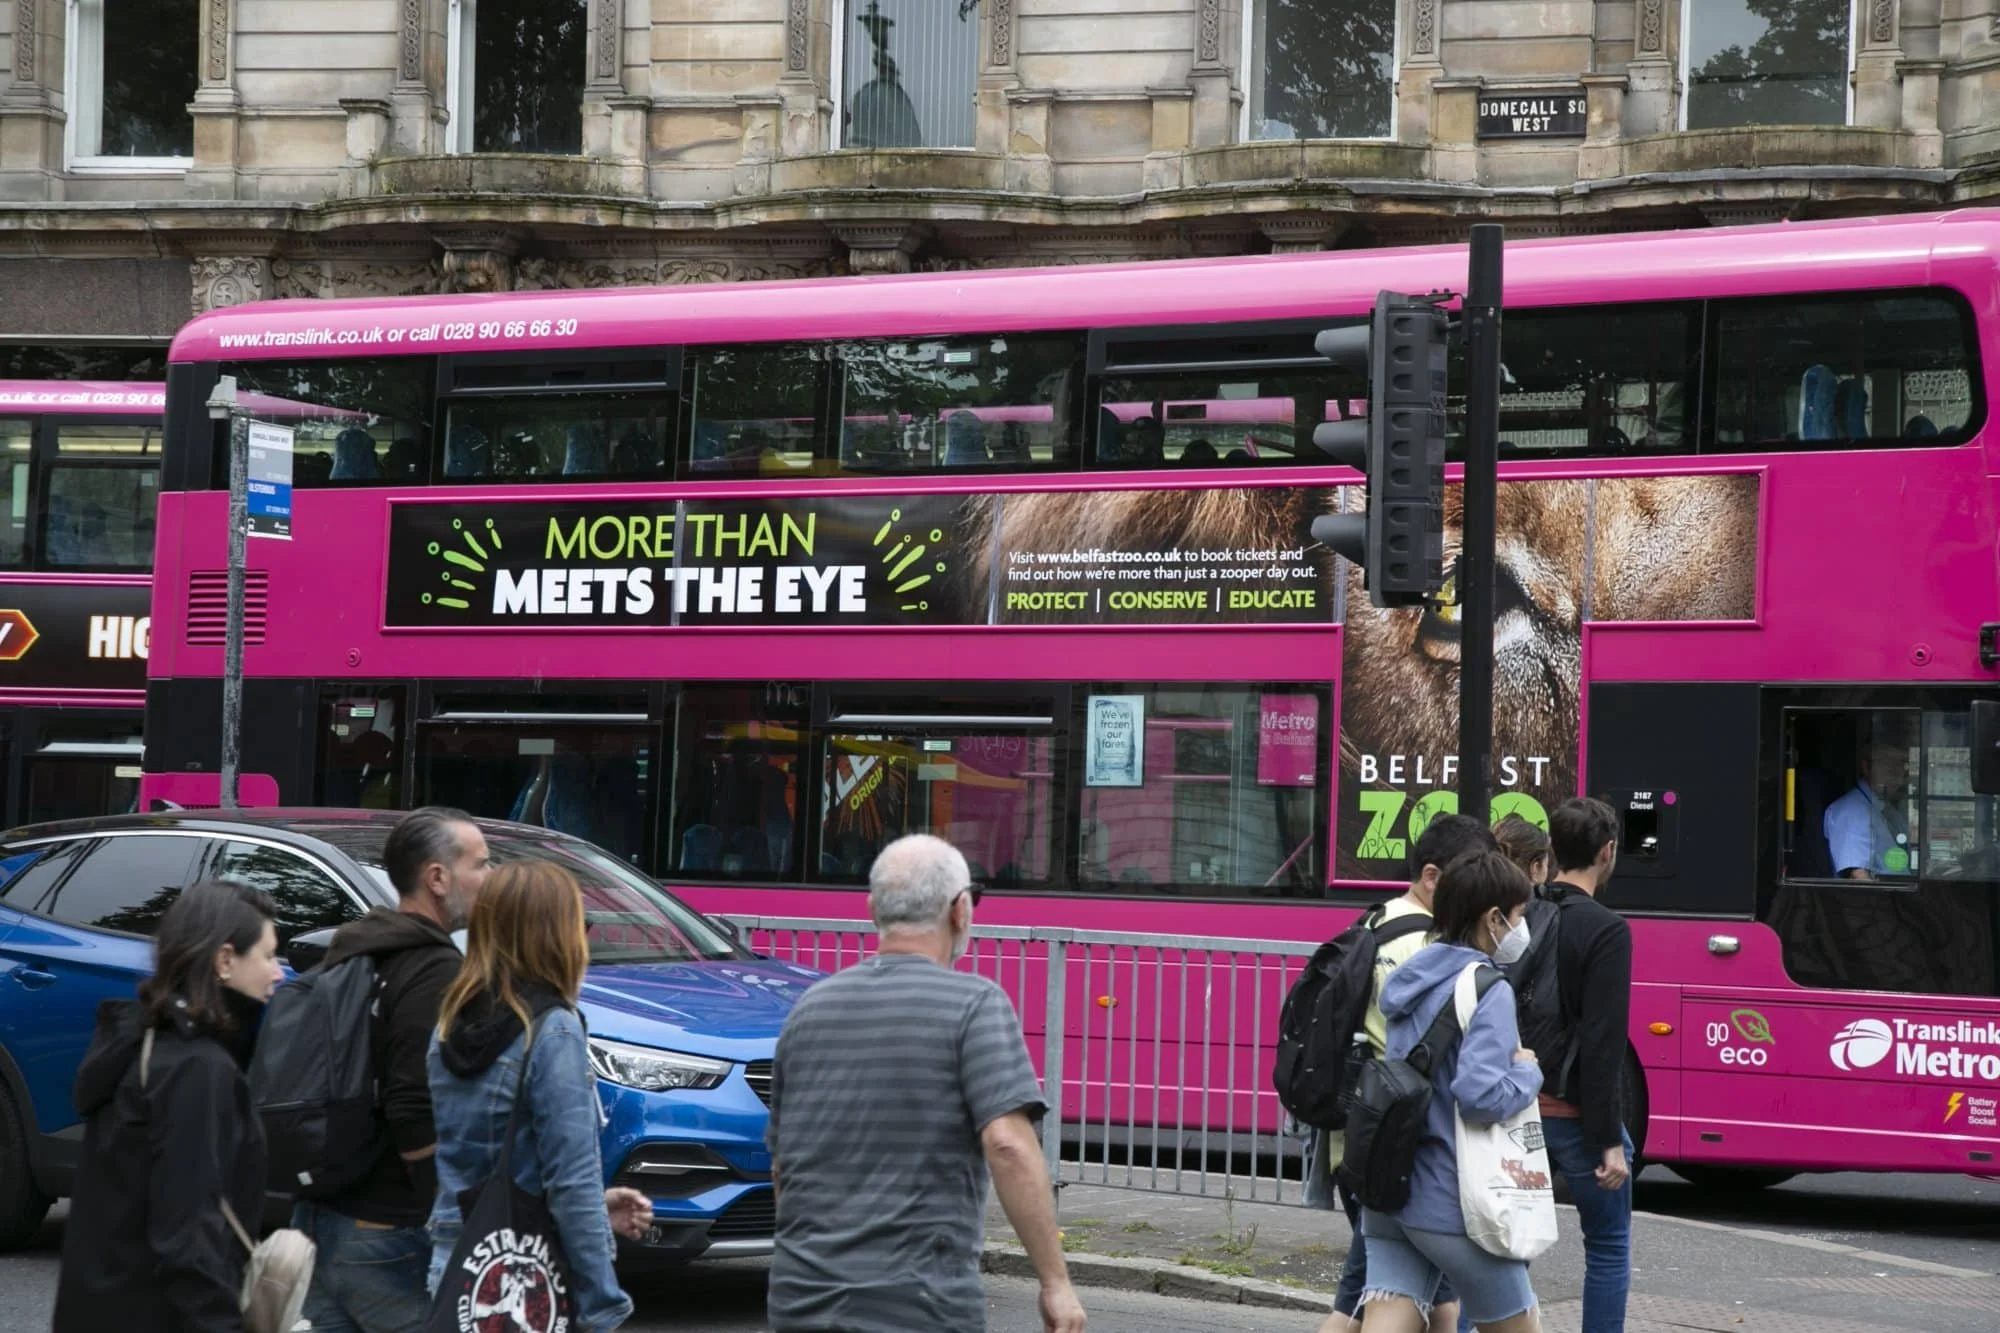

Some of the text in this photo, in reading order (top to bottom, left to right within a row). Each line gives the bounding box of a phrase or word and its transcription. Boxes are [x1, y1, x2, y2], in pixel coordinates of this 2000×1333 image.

[1480, 100, 1586, 116] DONEGALL SQ
[1512, 117, 1551, 131] WEST
[219, 319, 577, 348] www.translink.co.uk or call 028 90 66 66 30
[38, 394, 58, 404] or
[93, 393, 123, 404] 028
[127, 393, 147, 405] 90
[545, 512, 816, 559] MORE THAN
[1009, 547, 1303, 563] Visit www.belfastzoo.co.uk to book tickets and
[1008, 567, 1031, 580] find
[1034, 569, 1053, 580] out
[1057, 567, 1082, 580] how
[1085, 567, 1116, 580] we're
[1119, 569, 1150, 579] more
[1154, 566, 1181, 579] than
[1184, 566, 1207, 582] just
[1220, 568, 1263, 582] zooper
[1267, 565, 1288, 581] day
[1292, 567, 1317, 578] out.
[492, 565, 866, 614] MEETS THE EYE
[1007, 590, 1316, 609] PROTECT CONSERVE EDUCATE
[1100, 720, 1130, 729] frozen
[1261, 711, 1316, 730] Metro
[1106, 731, 1123, 739] our
[1360, 754, 1550, 786] BELFST
[1630, 801, 1654, 810] Diesel
[1706, 1022, 1729, 1046] go
[1892, 1018, 2000, 1046] Translink
[1719, 1047, 1768, 1066] eco
[1895, 1042, 2000, 1080] Metro
[1968, 1096, 1998, 1108] Battery
[1970, 1106, 1995, 1116] Boost
[1968, 1115, 1997, 1126] Socket
